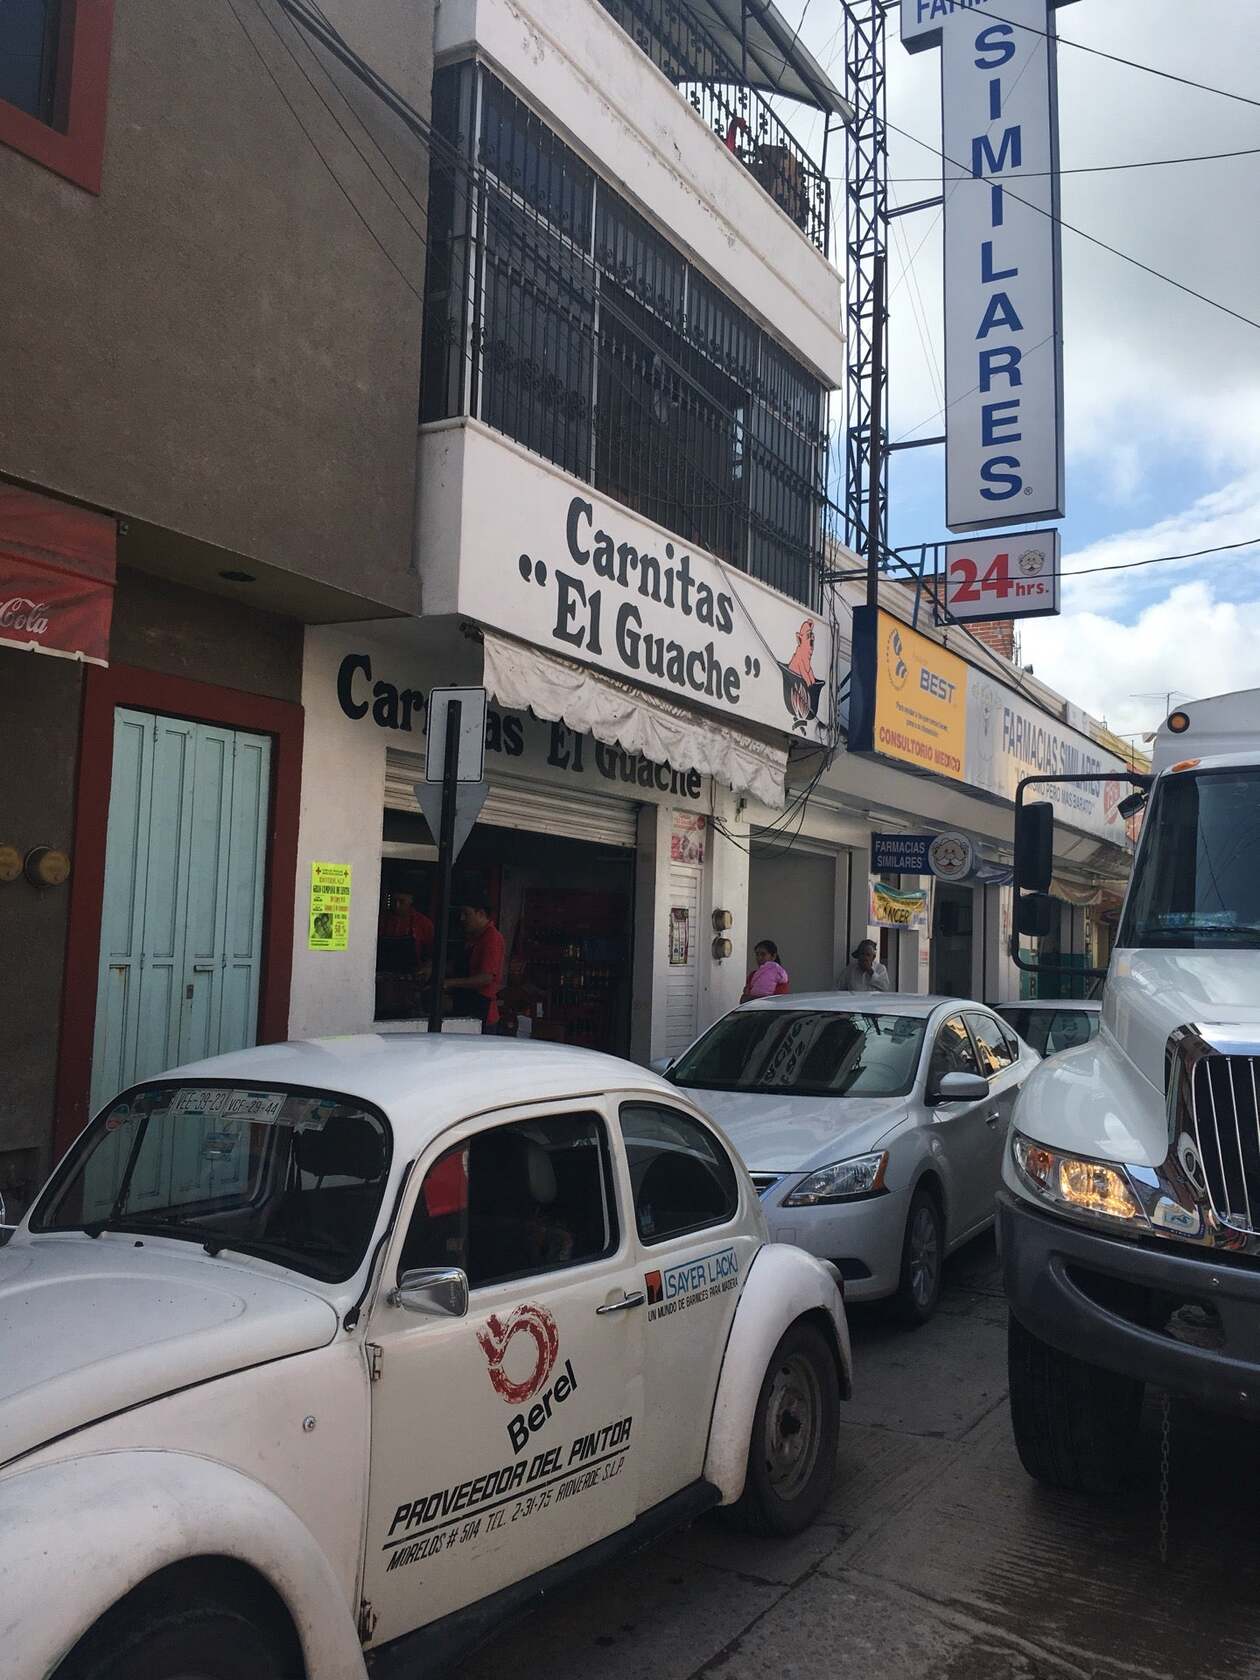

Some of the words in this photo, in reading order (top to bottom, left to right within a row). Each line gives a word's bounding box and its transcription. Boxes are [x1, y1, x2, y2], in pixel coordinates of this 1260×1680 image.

[971, 24, 1025, 500] SIMILARES
[565, 495, 734, 635] Carnitas
[949, 553, 1014, 604] 24
[1016, 581, 1049, 597] hrs.
[337, 653, 524, 757] Caras
[920, 667, 956, 704] BEST
[879, 725, 933, 761] CONSULTORIO
[1002, 706, 1058, 777] FARMACIAS
[875, 840, 926, 854] FARMACIAS
[876, 856, 922, 869] SIMILARES
[648, 1308, 657, 1322] UN
[657, 1301, 677, 1318] MUNDO
[678, 1296, 685, 1310] DE
[709, 1284, 721, 1298] PARA
[668, 1264, 707, 1298] SAYER
[708, 1254, 737, 1283] LACK
[507, 1359, 578, 1455] Berel
[387, 1459, 529, 1537] PROVEEDOR
[526, 1446, 563, 1484] DEL
[567, 1416, 633, 1466] PINTOR
[386, 1532, 447, 1573] MORELOS
[555, 1467, 602, 1503] RIOVERDE
